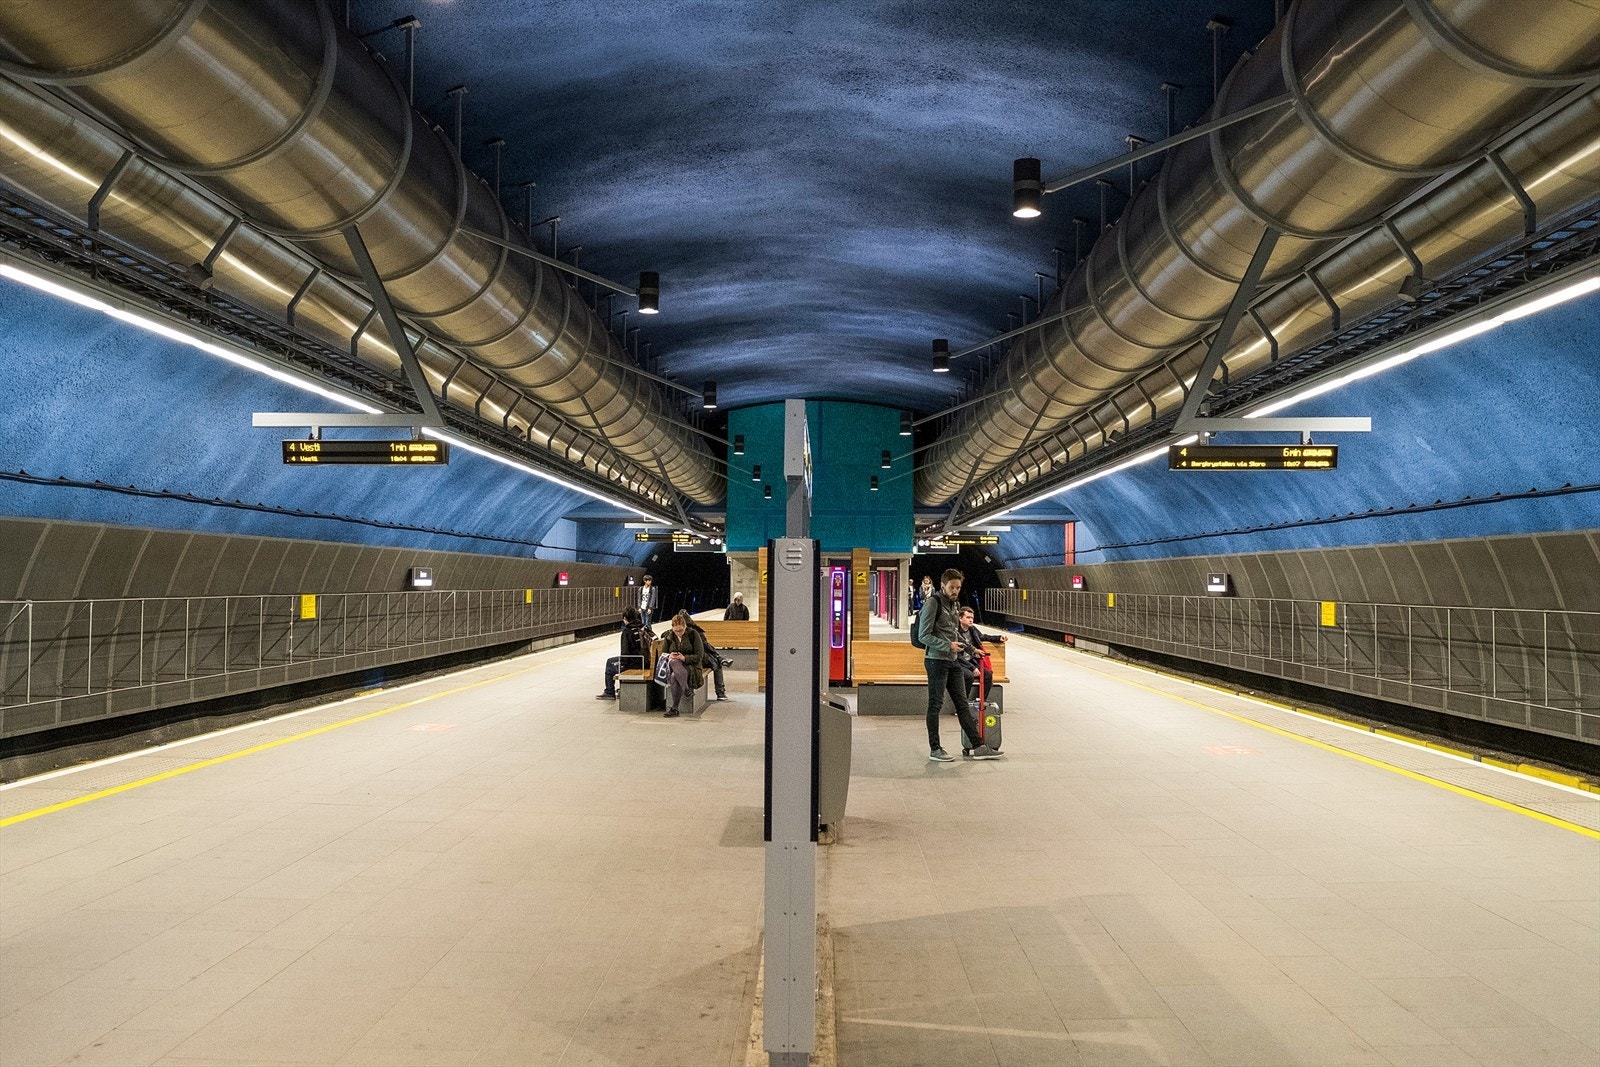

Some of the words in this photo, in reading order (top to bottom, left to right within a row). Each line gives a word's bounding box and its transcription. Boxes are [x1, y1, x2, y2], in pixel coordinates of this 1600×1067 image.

[289, 443, 296, 452] 4
[390, 443, 395, 452] 1
[395, 443, 407, 452] min
[1180, 448, 1187, 457] 4
[1283, 448, 1290, 457] 6
[1290, 448, 1301, 457] min
